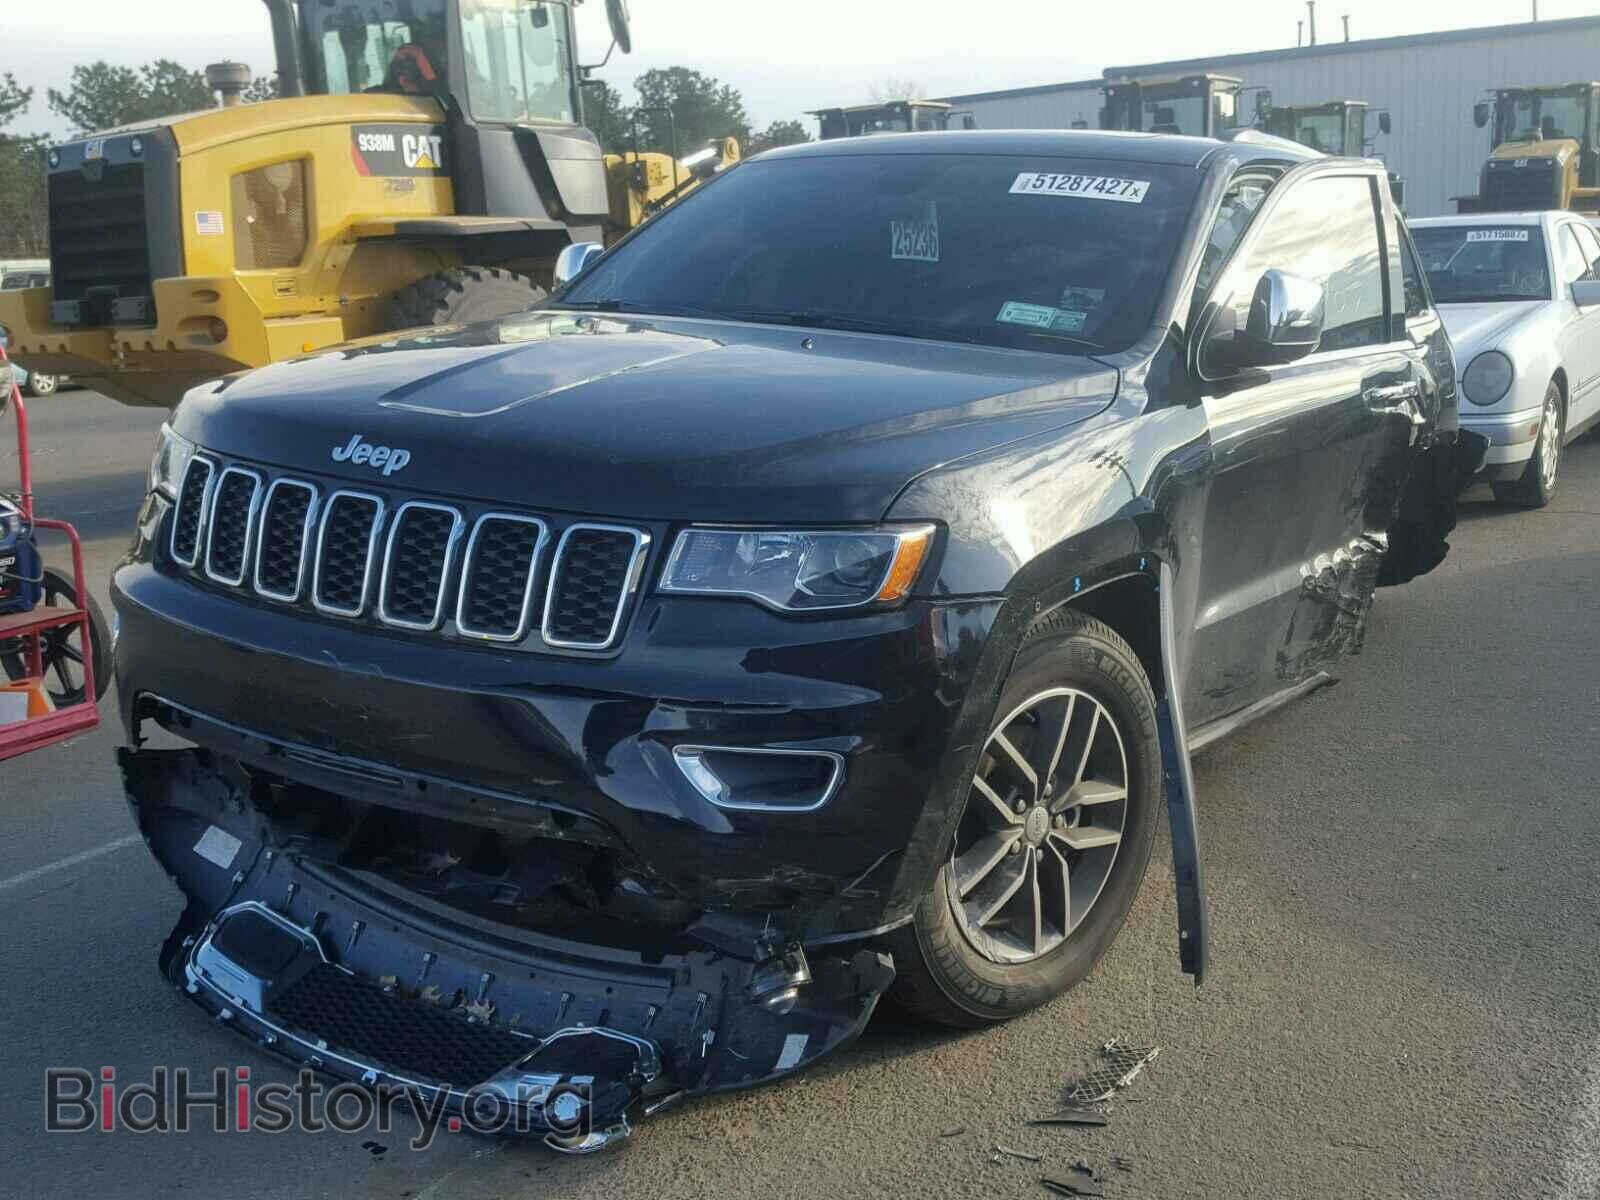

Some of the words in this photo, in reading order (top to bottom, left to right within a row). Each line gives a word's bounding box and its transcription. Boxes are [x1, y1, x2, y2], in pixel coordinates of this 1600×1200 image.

[358, 133, 395, 152] 938M
[402, 134, 442, 168] CAT
[332, 434, 411, 476] Jeep
